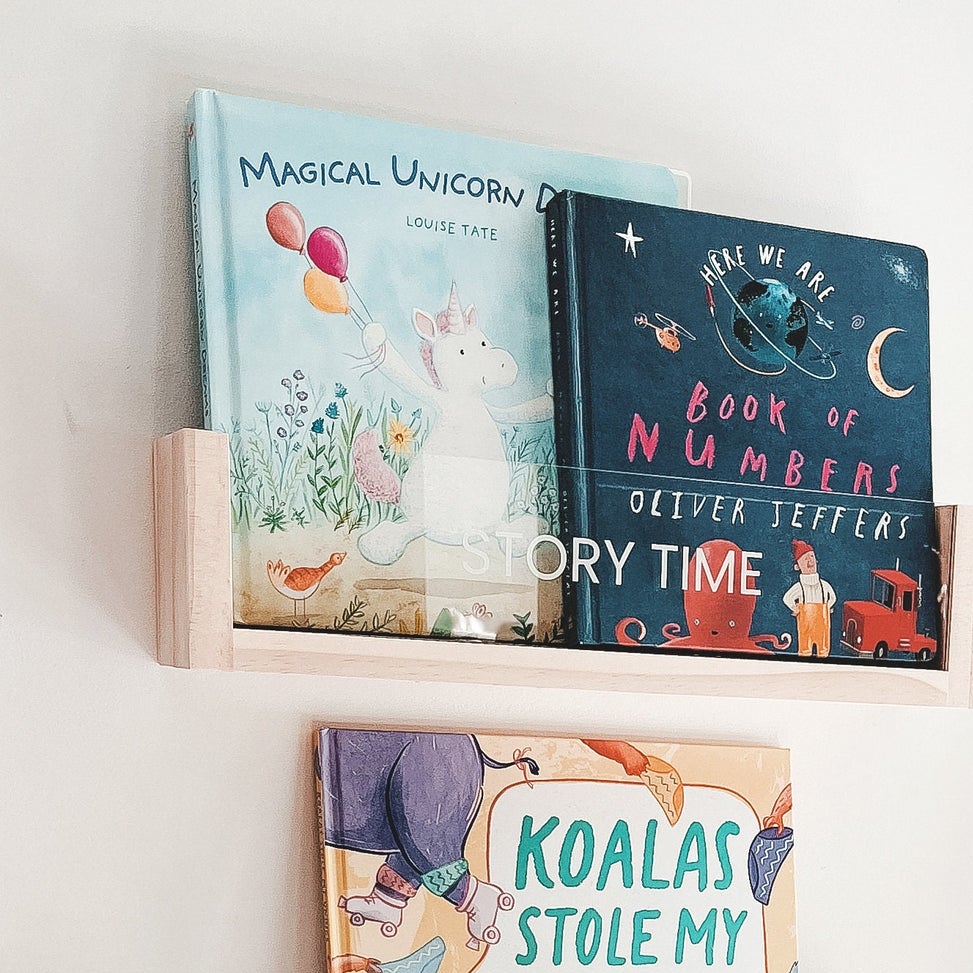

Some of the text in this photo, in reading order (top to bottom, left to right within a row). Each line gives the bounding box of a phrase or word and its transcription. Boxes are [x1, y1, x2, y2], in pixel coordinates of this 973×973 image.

[239, 152, 382, 188] MAGICAL
[391, 155, 525, 208] UNICORN
[406, 215, 498, 241] LOUISE TATE
[700, 244, 836, 303] HERE WE ARE
[686, 380, 860, 437] BOOK OF
[627, 413, 902, 496] NUMBERS
[630, 490, 911, 542] OLIVER JEFFERS
[462, 527, 636, 588] STORY
[651, 543, 763, 597] TIME
[515, 815, 741, 891] KOALAS
[515, 906, 749, 966] STOLE MY
